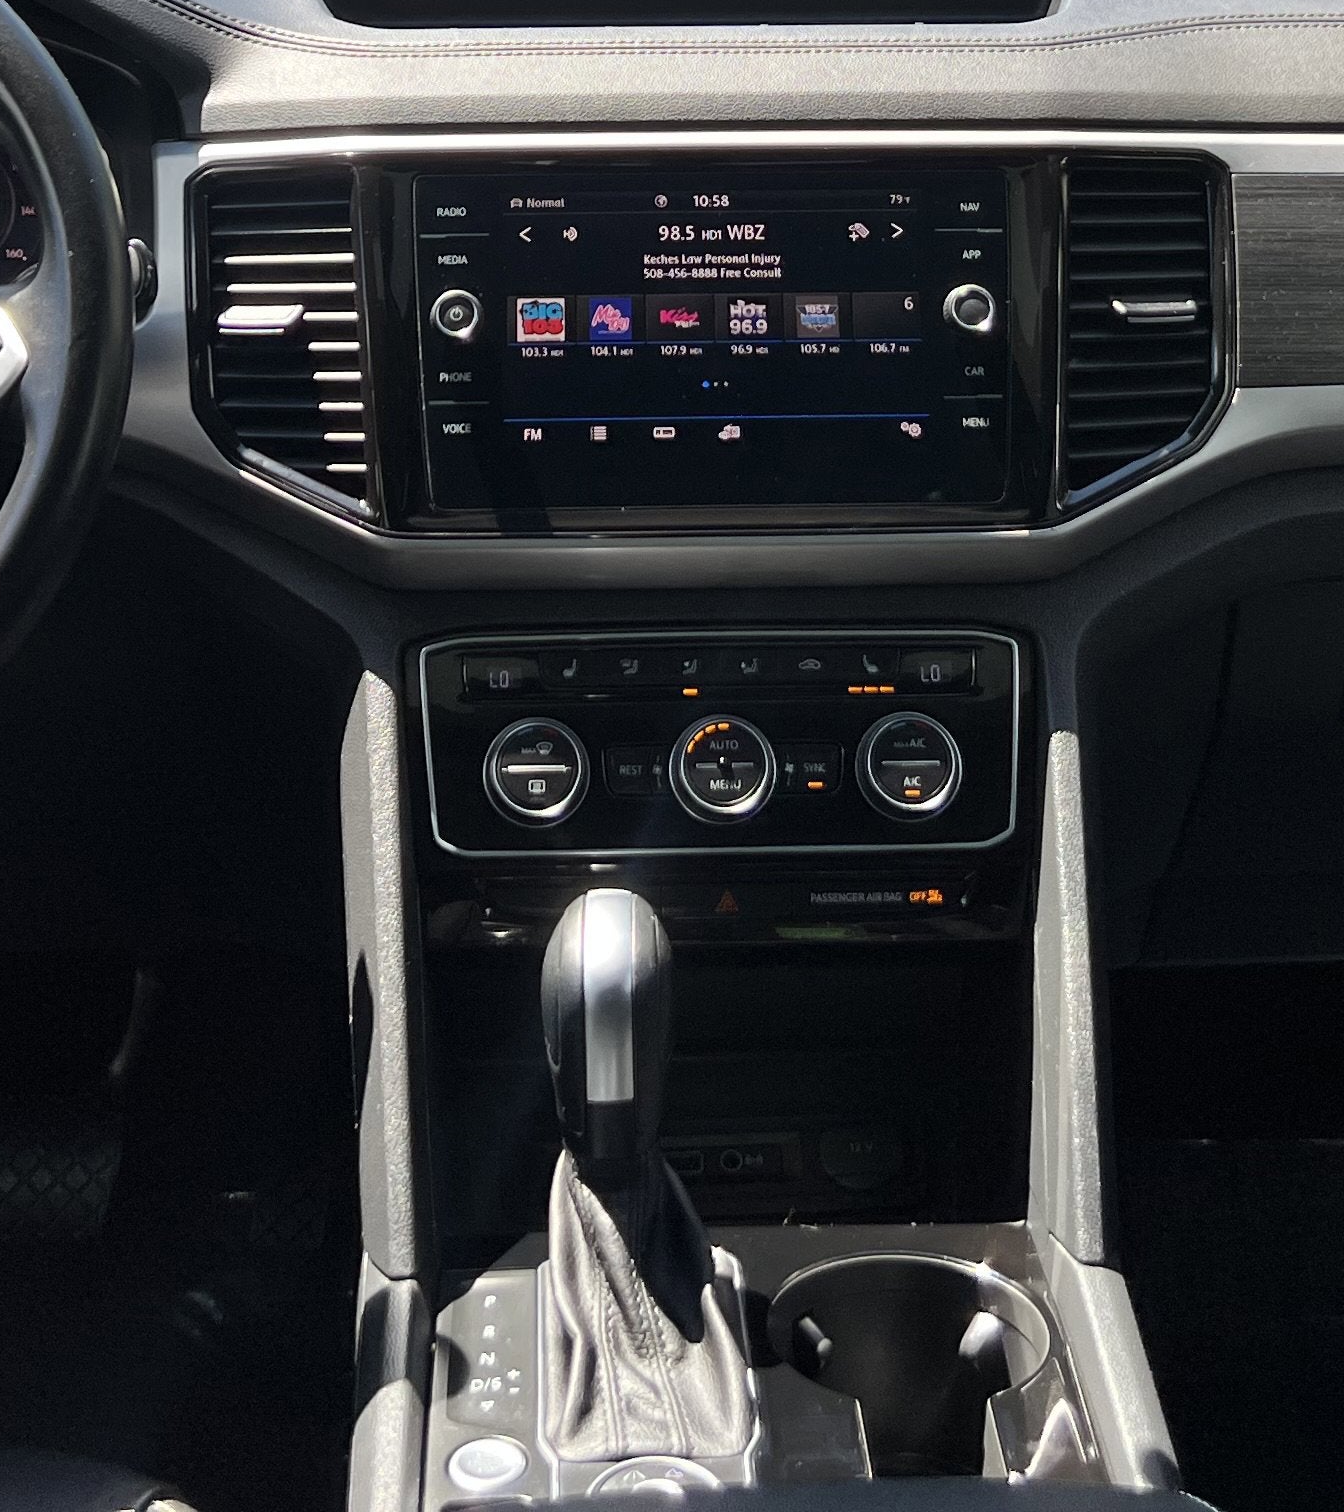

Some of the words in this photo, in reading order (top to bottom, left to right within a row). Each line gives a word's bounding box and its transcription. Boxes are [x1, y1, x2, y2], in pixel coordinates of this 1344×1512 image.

[526, 197, 565, 209] Normal
[693, 194, 730, 208] 10:58
[960, 202, 980, 212] NAV
[436, 207, 467, 217] RADIO
[658, 225, 695, 241] 98.5
[701, 230, 722, 240] HD1
[726, 224, 766, 240] WBZ
[6, 248, 24, 259] 160
[962, 250, 981, 259] APP
[437, 255, 468, 265] MEDIA
[643, 254, 680, 265] Keches
[681, 254, 703, 265] Law
[705, 254, 749, 265] Personal
[751, 253, 781, 266] Injury
[643, 267, 718, 279] 508-456-8888
[720, 267, 741, 278] Free
[743, 267, 782, 279] Consult
[904, 296, 914, 311] 6
[521, 302, 564, 319] BIG
[729, 319, 768, 335] 96.9
[521, 347, 548, 357] 103.3
[591, 346, 618, 356] 104.1
[660, 345, 687, 356] 107.9
[730, 344, 753, 355] 96.9
[800, 344, 826, 354] 105.7
[869, 343, 896, 353] 106.7
[964, 366, 984, 376] CAR
[439, 372, 472, 382] PHONE
[962, 417, 989, 428] MENU
[442, 423, 472, 434] VOICE
[523, 428, 542, 441] FM
[709, 739, 739, 751] AUTO
[619, 765, 642, 776] REST
[803, 762, 826, 773] SYNC
[709, 779, 741, 790] MENU
[810, 892, 865, 903] PASSENGER
[866, 891, 882, 902] AIR
[883, 891, 902, 902] BAG
[484, 1294, 497, 1309] P
[482, 1324, 496, 1339] R
[478, 1352, 496, 1366] N
